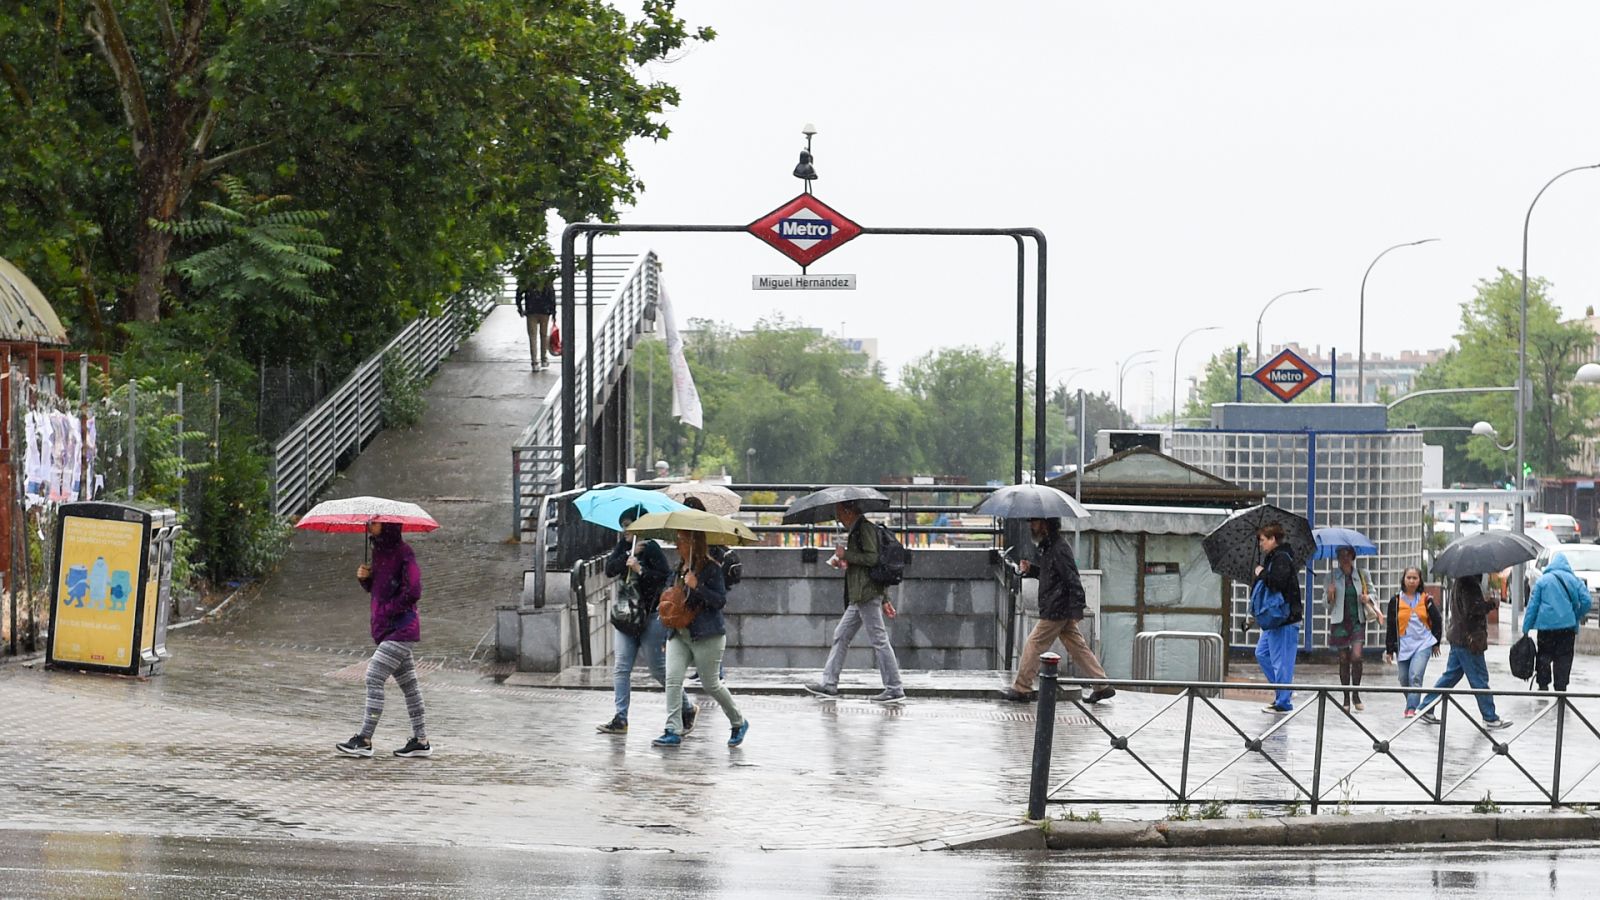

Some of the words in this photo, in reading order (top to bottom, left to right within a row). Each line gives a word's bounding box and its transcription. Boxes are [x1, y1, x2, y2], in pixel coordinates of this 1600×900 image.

[783, 222, 828, 236] Metro
[759, 277, 793, 289] Miguel
[795, 277, 849, 288] Hernández
[1271, 371, 1302, 381] Metro
